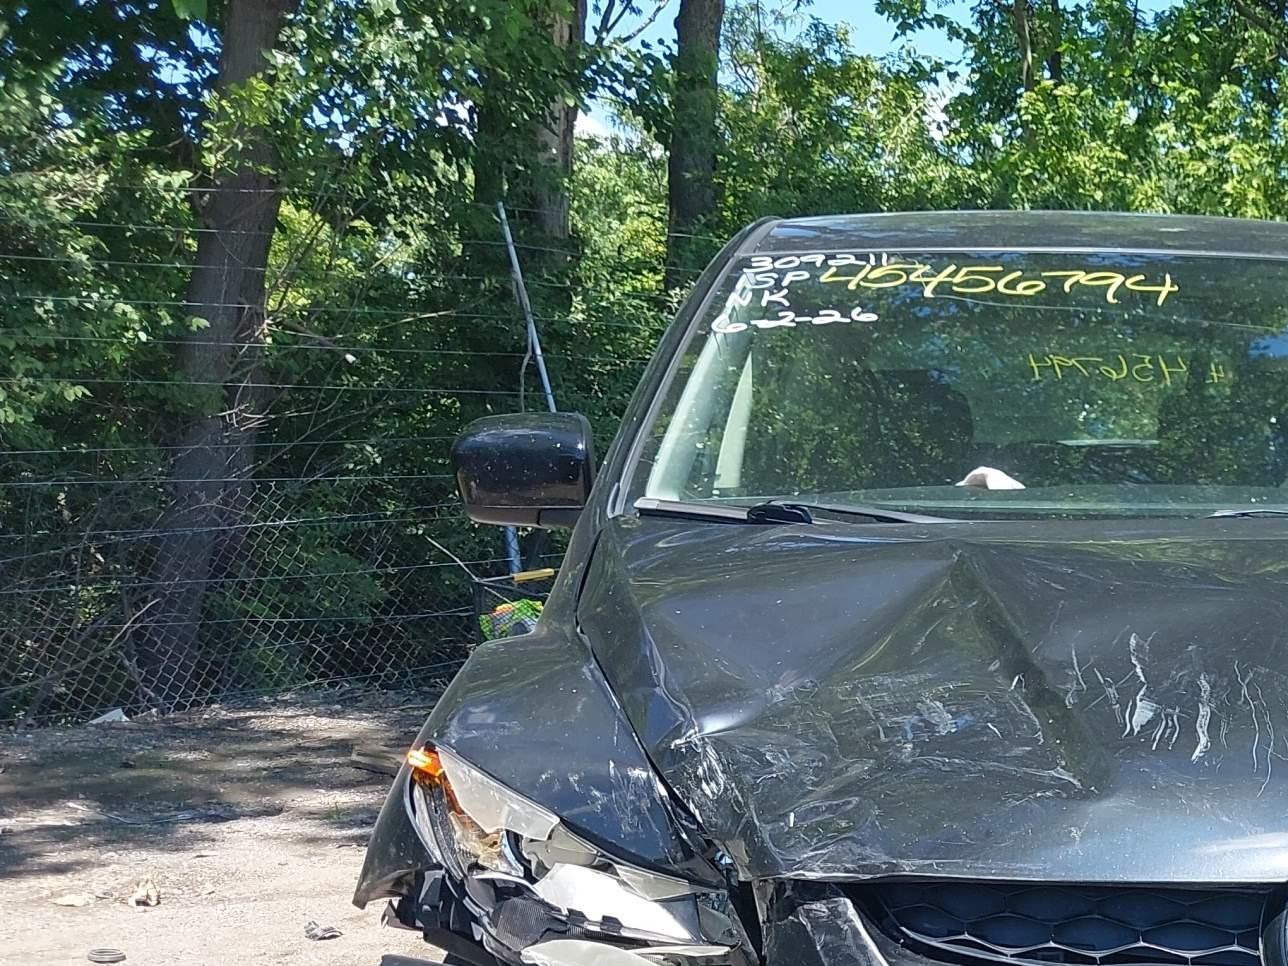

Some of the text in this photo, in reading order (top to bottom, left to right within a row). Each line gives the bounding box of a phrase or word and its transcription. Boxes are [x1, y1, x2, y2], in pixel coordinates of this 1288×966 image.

[743, 252, 888, 273] 309211
[819, 263, 1179, 307] 45456794
[711, 306, 879, 334] 6-2-26
